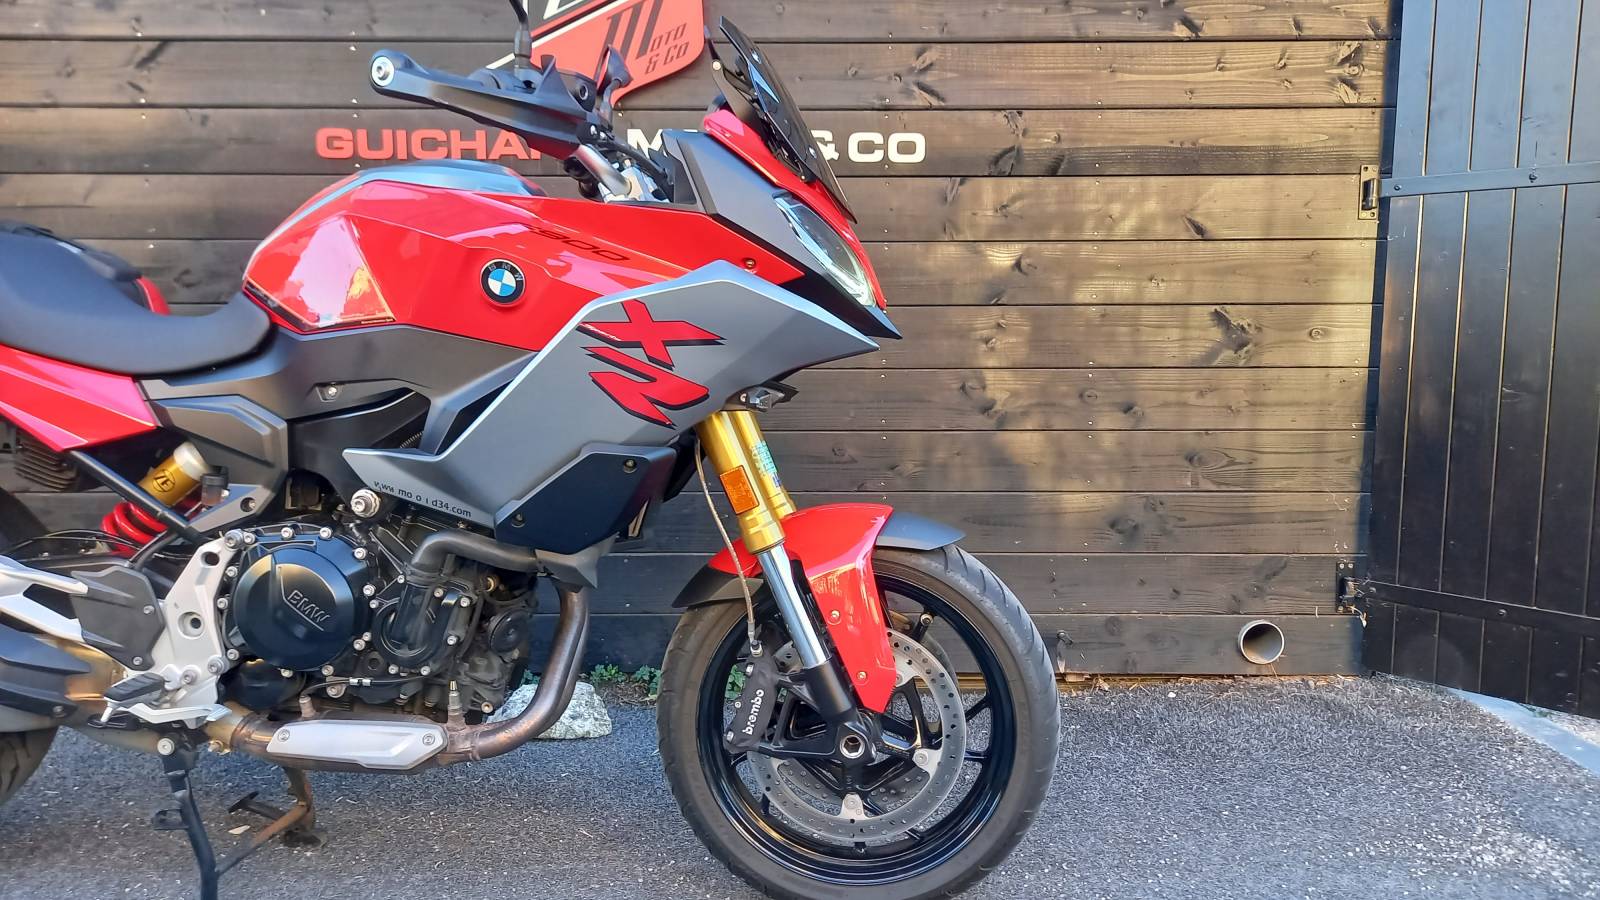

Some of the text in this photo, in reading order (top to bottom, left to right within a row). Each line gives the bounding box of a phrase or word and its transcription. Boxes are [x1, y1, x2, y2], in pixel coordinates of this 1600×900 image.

[315, 126, 541, 162] GUICHA
[847, 131, 927, 164] CO
[287, 590, 331, 623] BMW
[741, 689, 765, 735] brembo
